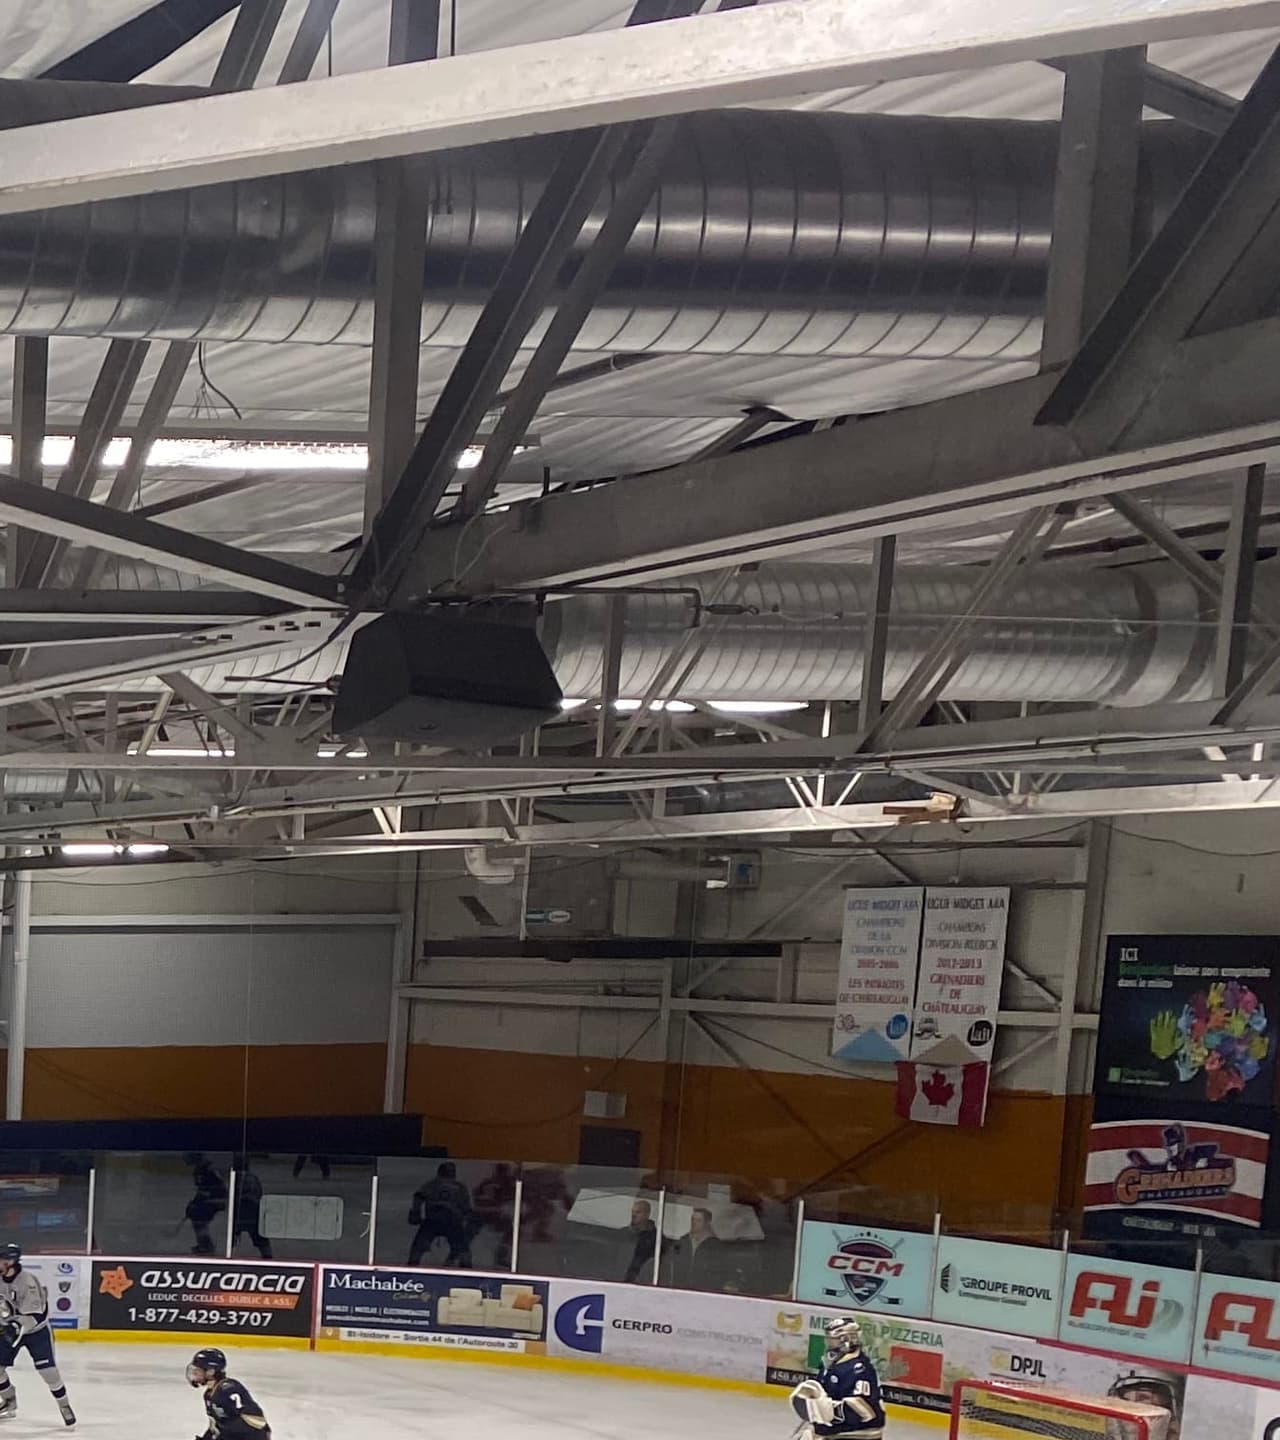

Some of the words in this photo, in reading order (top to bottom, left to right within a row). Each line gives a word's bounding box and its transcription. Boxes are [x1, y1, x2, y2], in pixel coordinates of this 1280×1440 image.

[1120, 948, 1138, 961] ICI
[827, 1254, 904, 1277] CCM
[141, 1271, 306, 1293] assurancia
[328, 1273, 424, 1292] Machabée
[961, 1276, 1008, 1294] GROUPE
[1010, 1284, 1052, 1300] PROVIL
[148, 1293, 178, 1301] LEDUC
[182, 1294, 224, 1303] DECELLES
[128, 1307, 273, 1328] 1-877-429-3707
[404, 1333, 430, 1341] Sortie
[458, 1337, 506, 1347] l'Autoroute
[612, 1319, 673, 1334] GERPRO
[677, 1328, 763, 1345] CONSTRUCTION
[881, 1326, 944, 1348] PIZZERIA
[1010, 1355, 1046, 1378] DPJL
